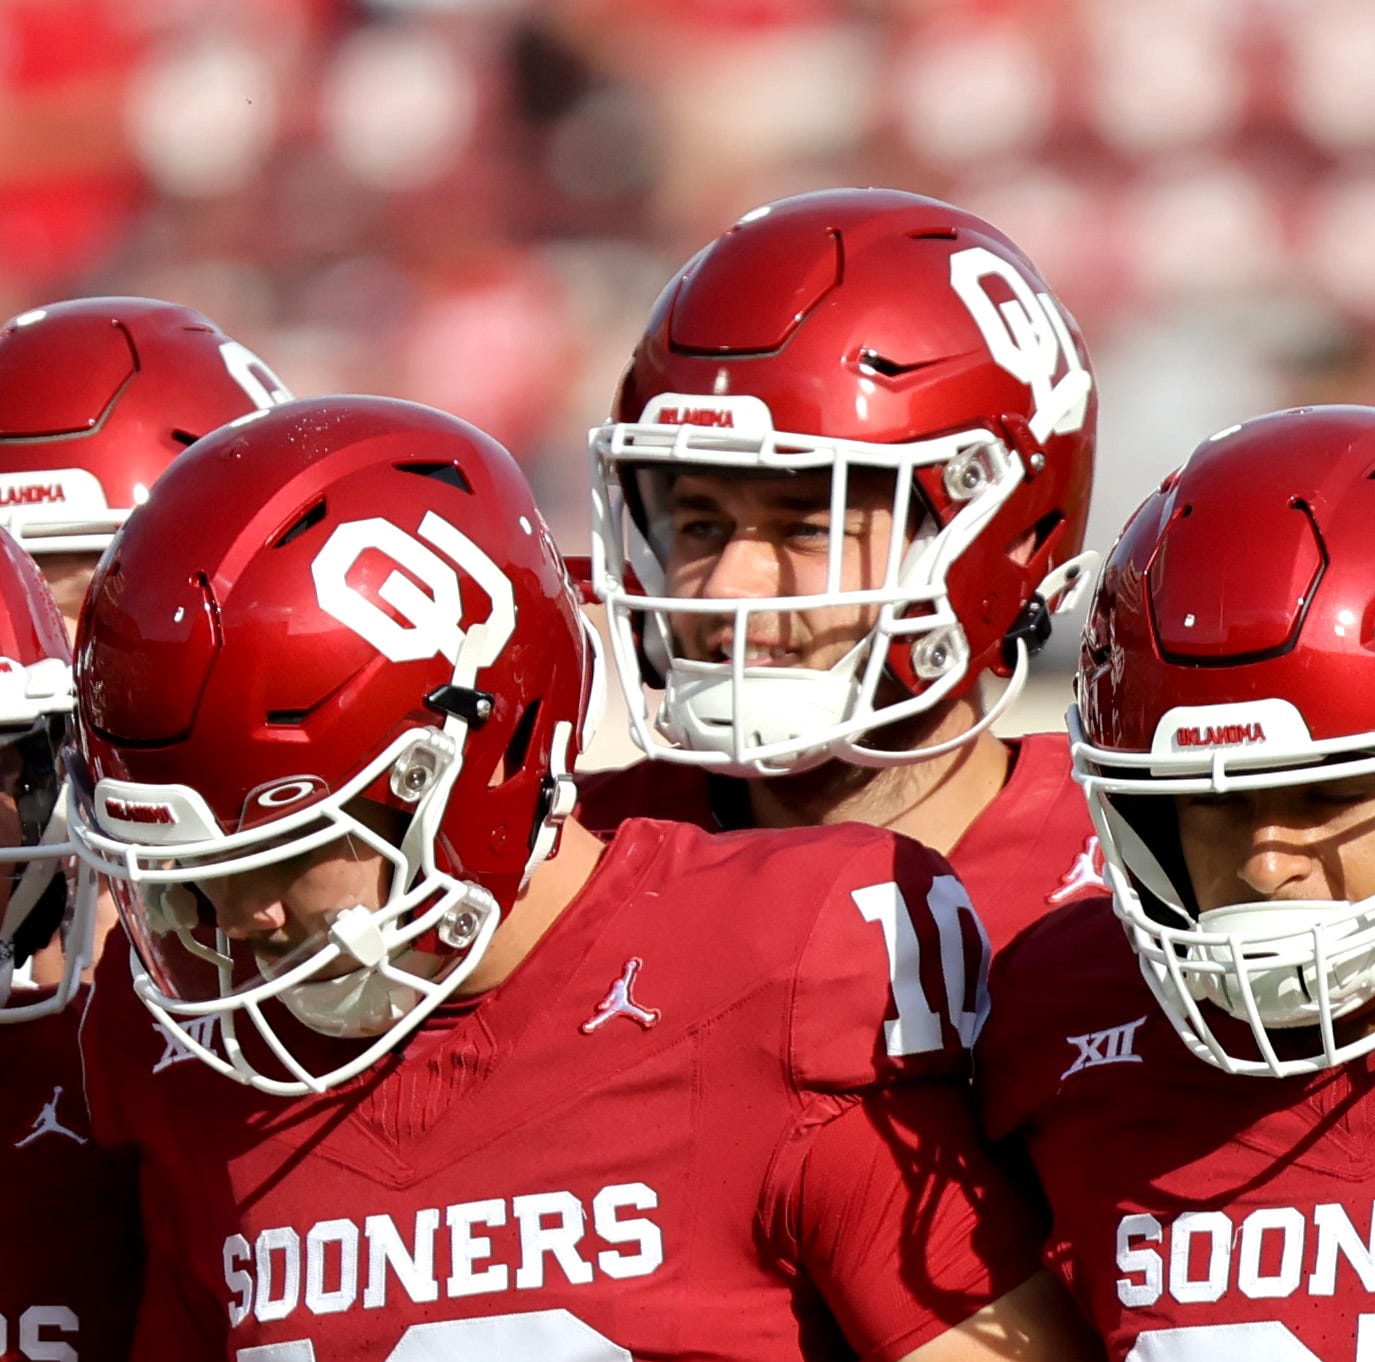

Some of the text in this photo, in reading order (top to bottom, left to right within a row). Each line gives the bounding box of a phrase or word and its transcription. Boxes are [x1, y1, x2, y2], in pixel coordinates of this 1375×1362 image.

[311, 511, 517, 670] OU
[1176, 721, 1266, 747] OKLAHOMA
[851, 874, 992, 1057] 10
[1060, 1016, 1147, 1081] XII
[223, 1182, 665, 1328] SOONERS
